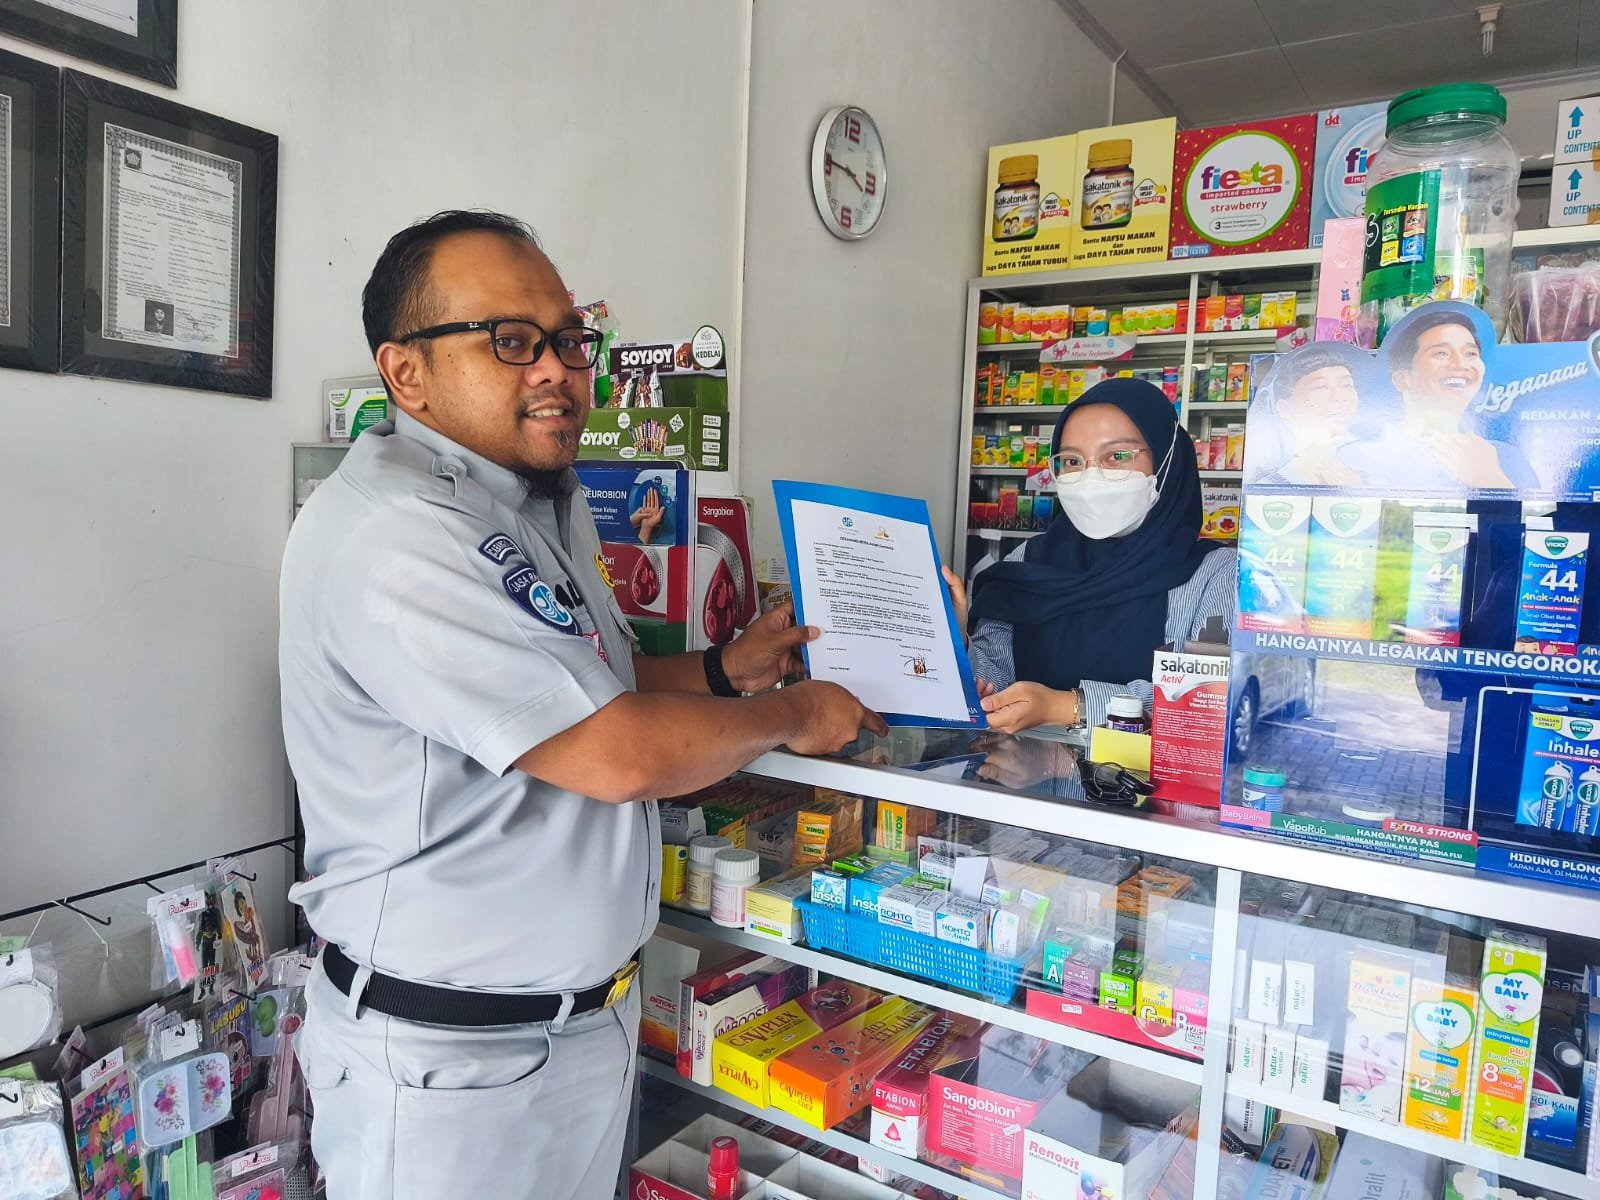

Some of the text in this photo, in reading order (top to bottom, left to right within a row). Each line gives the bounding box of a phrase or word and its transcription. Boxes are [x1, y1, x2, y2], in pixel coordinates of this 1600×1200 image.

[845, 115, 860, 144] 12
[1567, 130, 1582, 140] UP
[865, 171, 876, 196] 3
[1200, 161, 1283, 190] fiesta
[1084, 180, 1121, 193] sakatonik
[1205, 186, 1275, 200] imported condoms
[1566, 191, 1581, 202] UP
[1210, 201, 1268, 214] strawberry
[840, 205, 852, 229] 6
[1214, 221, 1222, 231] 3
[1100, 234, 1126, 243] NAFSU
[1127, 231, 1156, 240] MAKAN
[1010, 245, 1033, 255] NAFSU
[1034, 242, 1061, 252] MAKAN
[1087, 250, 1107, 259] DAYA
[1109, 248, 1135, 257] TAHAN
[1137, 245, 1163, 254] TUBUH
[998, 261, 1017, 270] DAYA
[1018, 259, 1041, 268] TAHAN
[1043, 257, 1068, 266] TUBUH
[621, 349, 673, 366] SOYJOY
[1520, 410, 1591, 421] REDAKAN
[582, 490, 627, 499] NEUROBION
[1204, 493, 1239, 502] sakatonik
[702, 506, 735, 519] Sangobion
[1265, 511, 1290, 519] VICKS
[1264, 547, 1296, 567] 44
[1331, 549, 1365, 569] 44
[1425, 562, 1459, 583] 44
[1528, 561, 1558, 570] Formula
[511, 575, 531, 593] JASA
[1540, 569, 1579, 592] 44
[1522, 592, 1580, 604] Anak-Anak
[1255, 633, 1364, 656] HANGATNYA
[1368, 640, 1458, 664] LEGAKAN
[1196, 691, 1227, 702] Gummy
[1548, 740, 1600, 758] Inhale
[1222, 809, 1264, 823] BabyBalm
[1544, 798, 1554, 829] Inhaler
[1578, 805, 1592, 835] Inhaler
[1283, 820, 1327, 835] VapoRub
[1390, 822, 1473, 841] EXTRA STRONG
[1356, 829, 1440, 848] HANGATNYA PAS
[1509, 852, 1560, 868] HIDUNG
[1508, 862, 1534, 872] KAPAN
[1564, 871, 1589, 881] MANA
[813, 887, 842, 905] insto
[881, 908, 913, 922] ROHTO
[942, 924, 971, 937] ROHTO
[1047, 963, 1059, 983] A
[1503, 977, 1523, 989] MY
[1494, 986, 1529, 1000] BABY
[1140, 1006, 1159, 1023] C
[1434, 1006, 1453, 1017] MY
[730, 1010, 799, 1047] CAVIPLEX
[1176, 1011, 1188, 1030] B
[1426, 1014, 1458, 1028] BABY
[897, 1017, 956, 1071] ETABION
[1486, 1030, 1530, 1046] minyak telon
[1487, 1051, 1528, 1067] Eucalyptus
[1509, 1047, 1529, 1059] plus
[719, 1063, 759, 1091] CAVIPLEX
[1481, 1062, 1499, 1084] 8
[779, 1081, 814, 1105] CAVIPLEX
[1413, 1075, 1450, 1099] 12 JAM
[1500, 1079, 1523, 1092] HOURS
[875, 1088, 916, 1108] ETABION
[943, 1086, 1016, 1120] Sangobion
[1551, 1100, 1576, 1113] KAIN
[1029, 1140, 1081, 1171] Renovit
[1261, 1154, 1292, 1198] DIAPET
